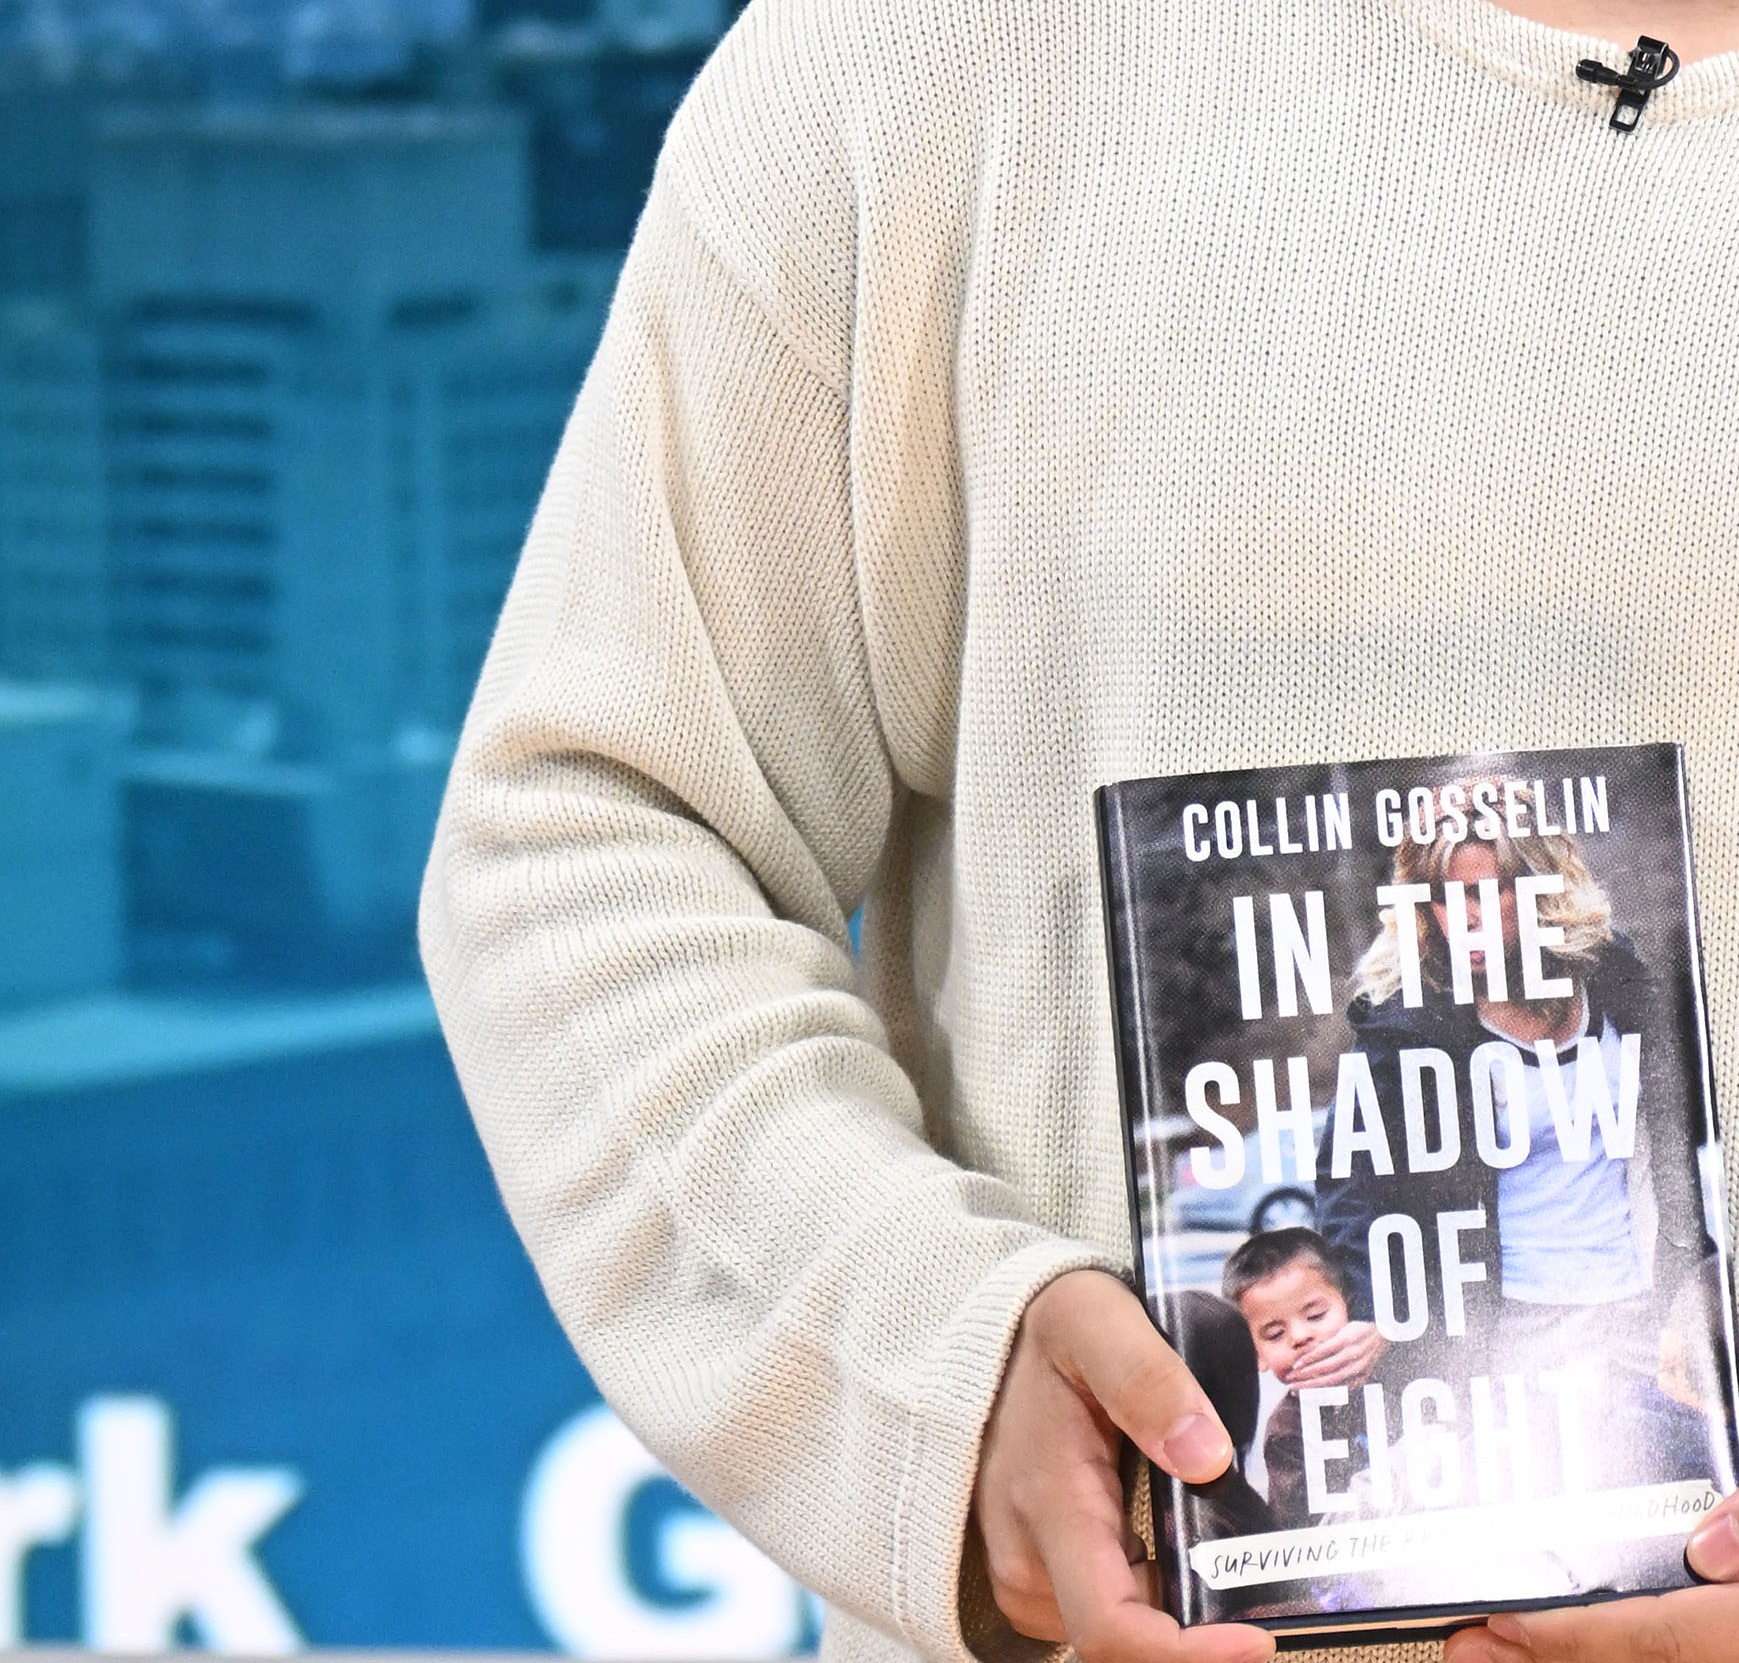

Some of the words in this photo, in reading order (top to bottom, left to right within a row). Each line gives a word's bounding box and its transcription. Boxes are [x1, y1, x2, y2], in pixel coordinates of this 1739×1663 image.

[1183, 792, 1352, 862] COLLIN
[1375, 776, 1611, 846] GOSSELIN
[1232, 889, 1334, 1021] IN
[1378, 874, 1574, 1009] THE
[1183, 1033, 1642, 1191] SHADOW
[1368, 1209, 1489, 1342] OF
[1299, 1366, 1598, 1514] EIGHT
[1210, 1539, 1339, 1580] SURVIVING
[1348, 1533, 1392, 1559] THE
